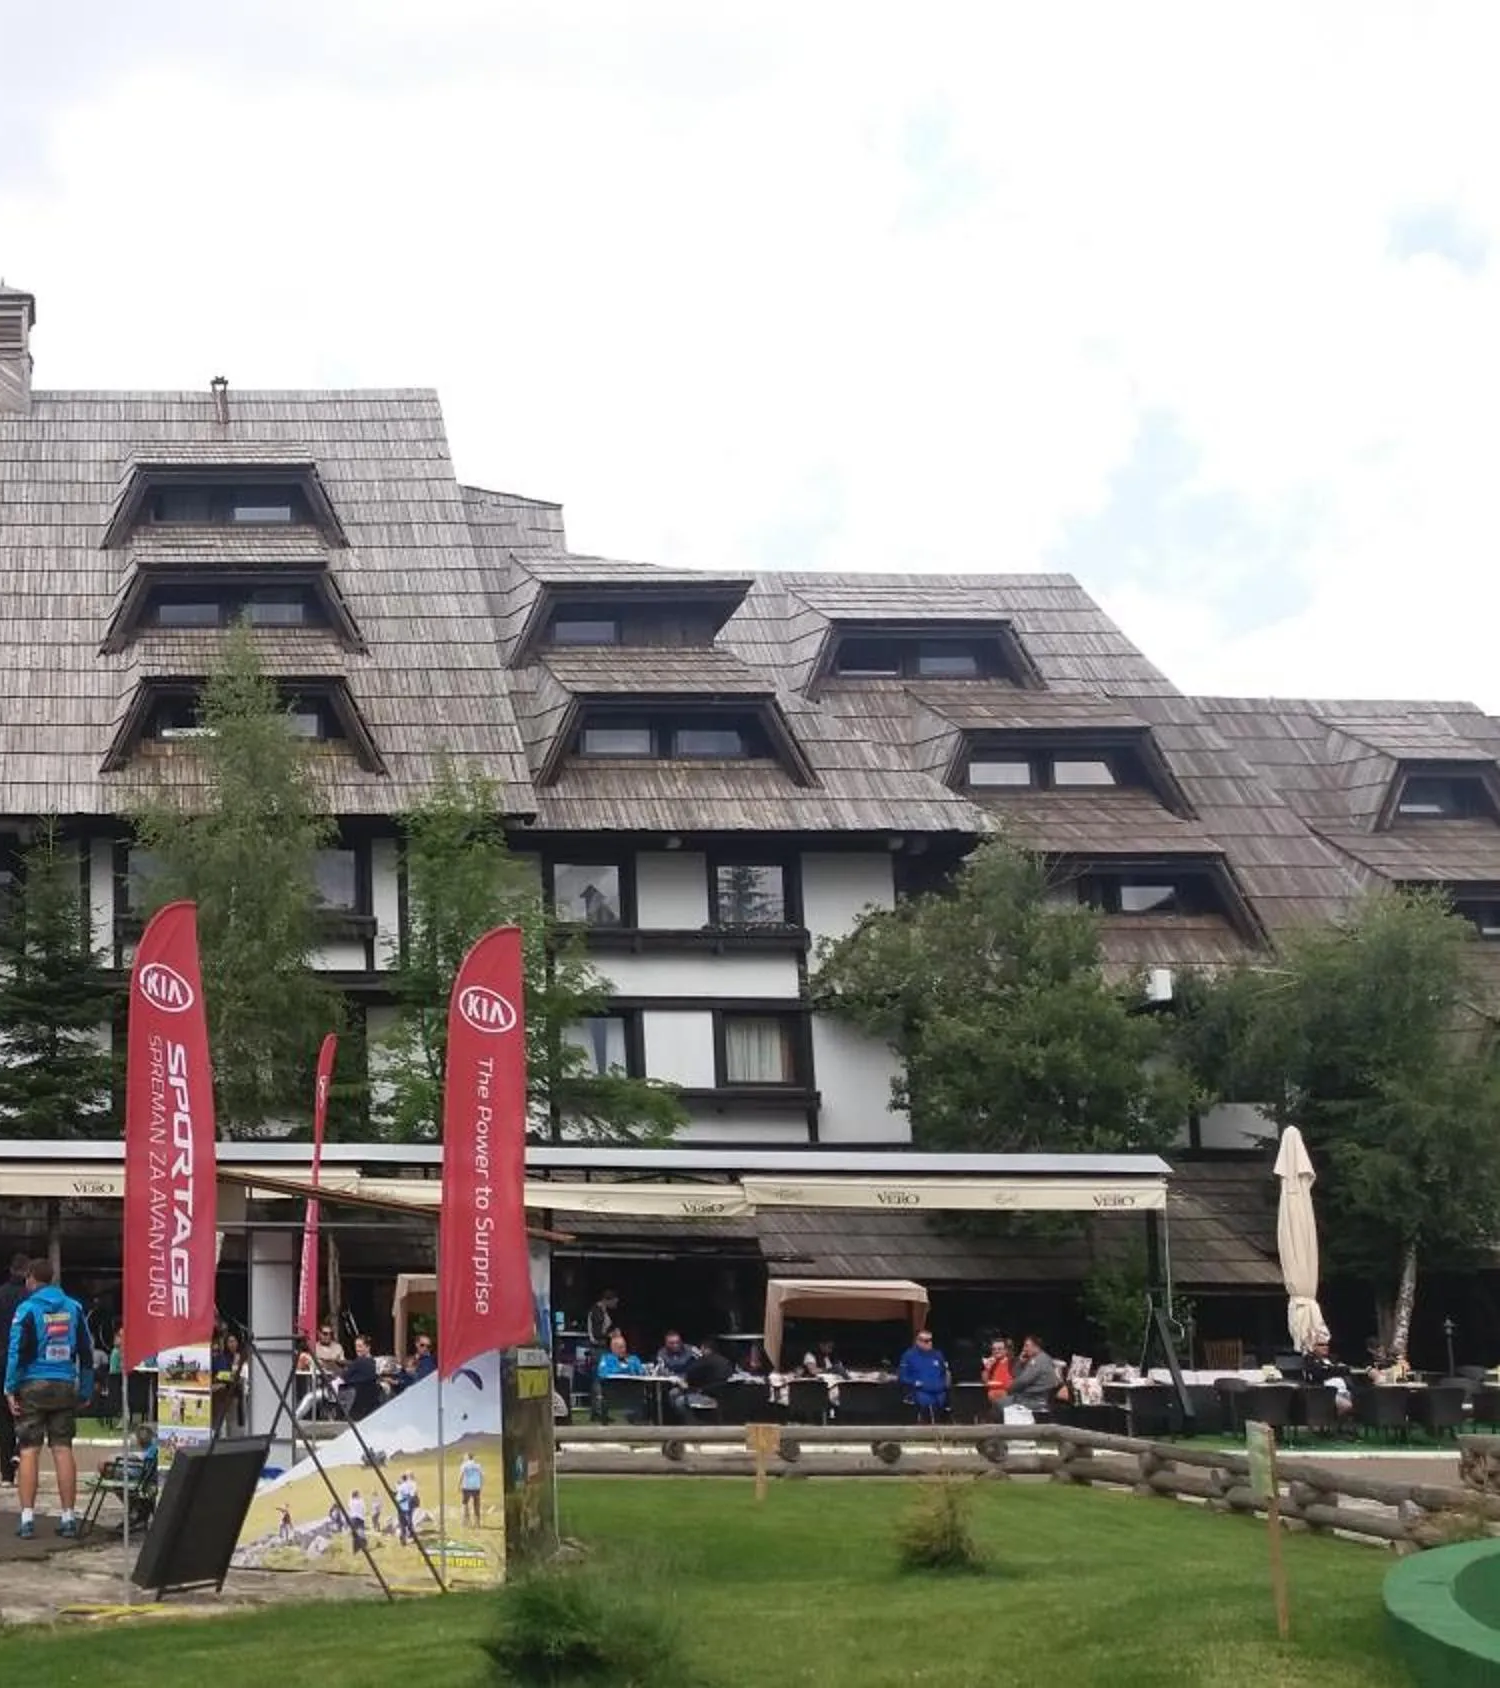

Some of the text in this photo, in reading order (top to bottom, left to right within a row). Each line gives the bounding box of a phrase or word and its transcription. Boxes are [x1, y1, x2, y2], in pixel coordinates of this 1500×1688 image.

[147, 972, 184, 1005] KIA
[466, 993, 507, 1026] KIA
[147, 1034, 167, 1317] SPREMAN ZA AVANTURU
[168, 1040, 194, 1319] SPORTAGE
[472, 1057, 495, 1315] The Power to Surprise
